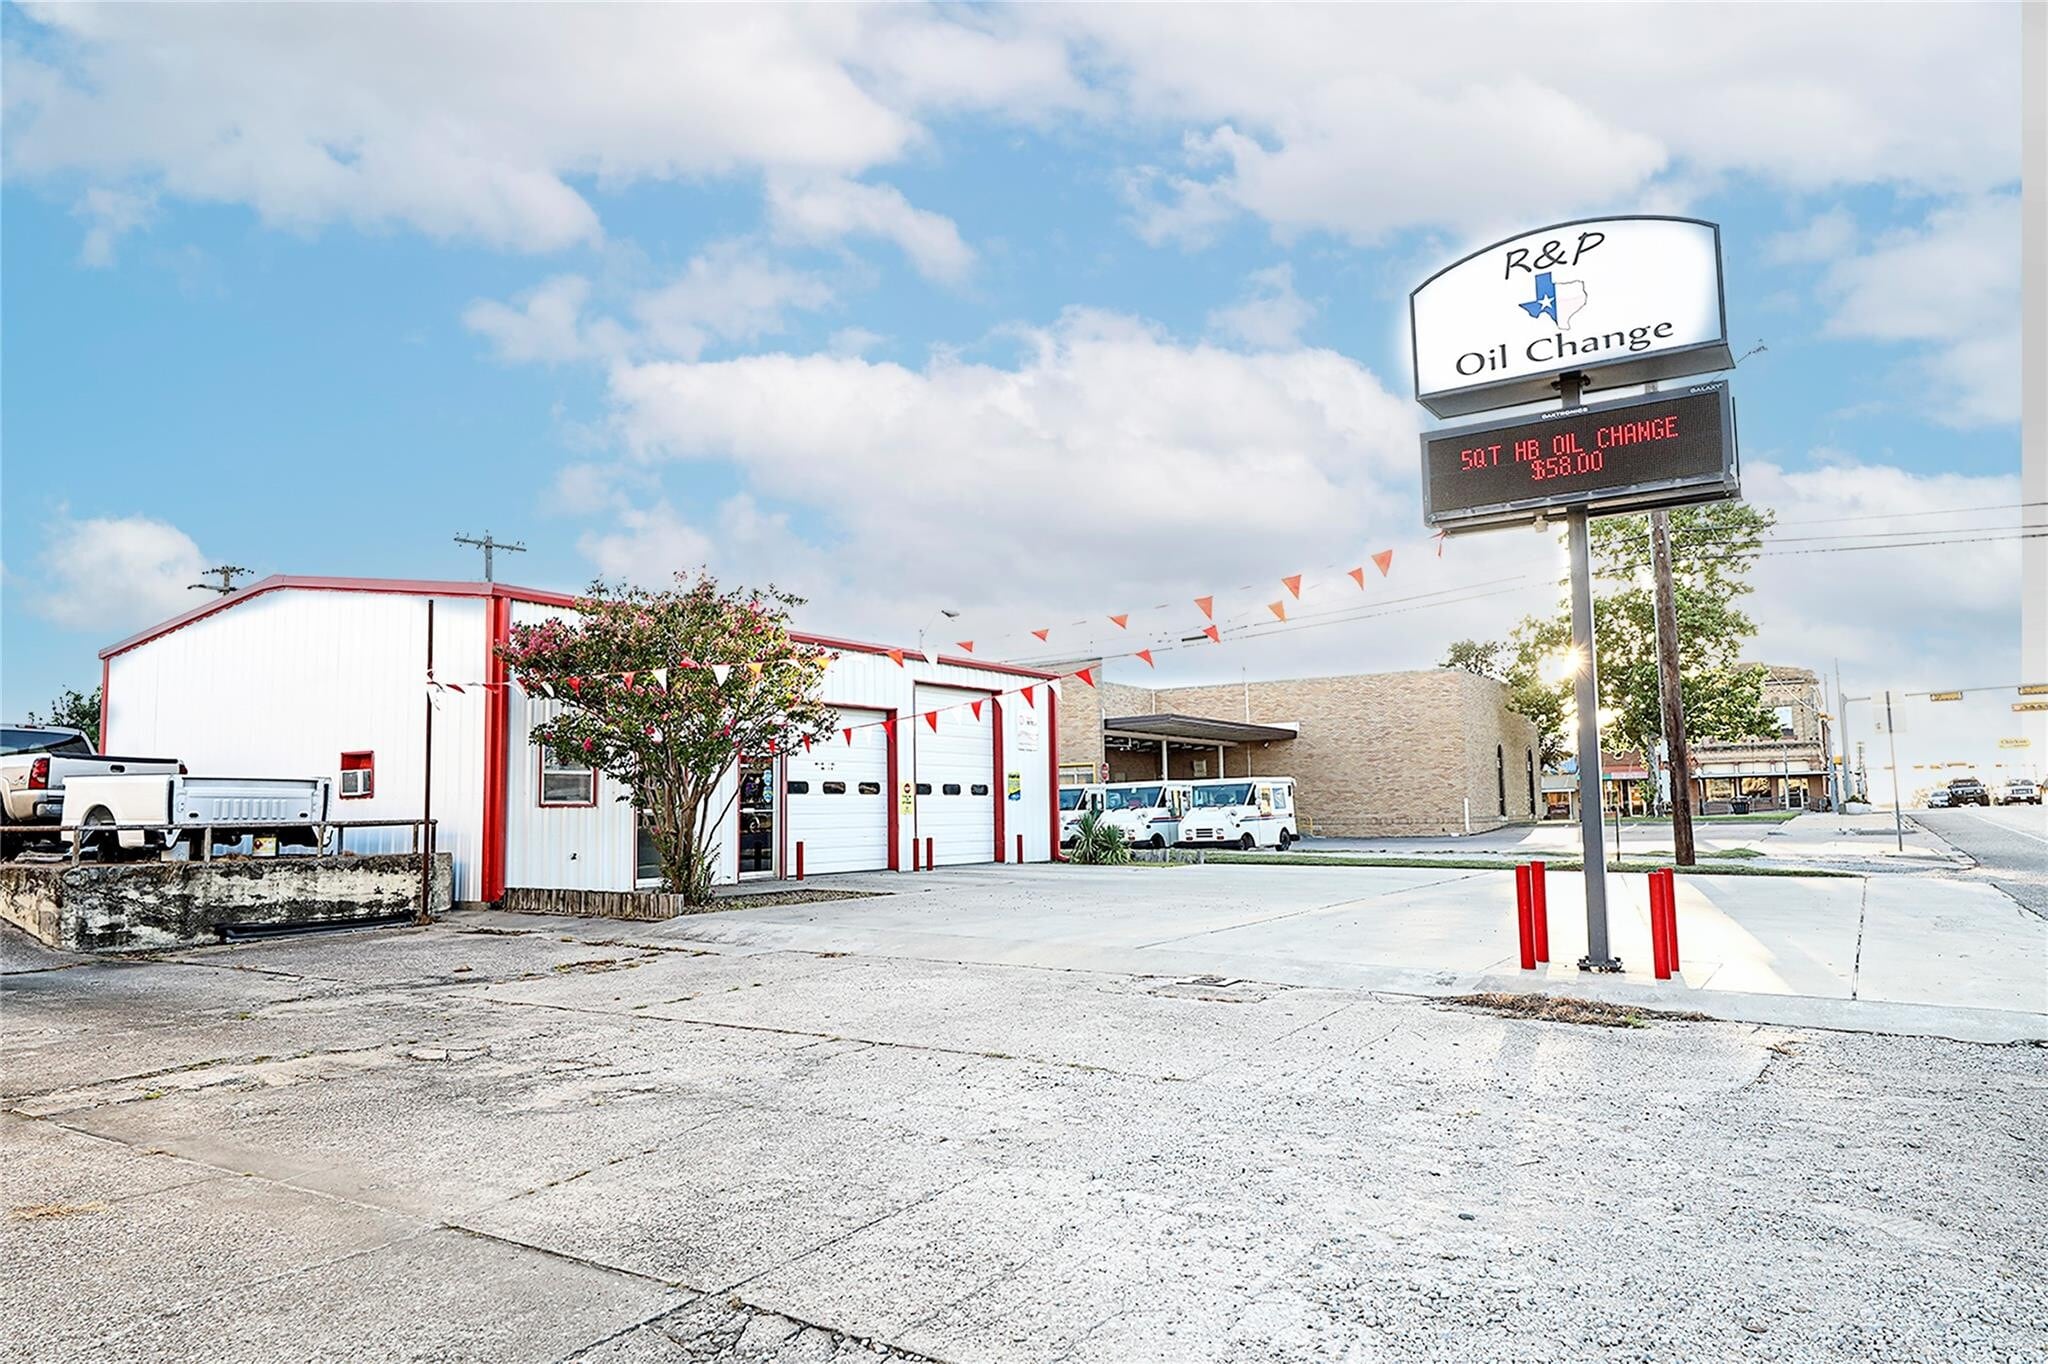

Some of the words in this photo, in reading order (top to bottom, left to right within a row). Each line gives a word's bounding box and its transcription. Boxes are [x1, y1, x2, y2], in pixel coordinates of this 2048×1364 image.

[1505, 232, 1605, 280] R&P
[1455, 343, 1507, 376] Oil
[1526, 321, 1675, 363] Change
[1514, 439, 1540, 462] HB
[1553, 432, 1584, 455] OIL
[1597, 415, 1679, 449] CHANGE
[1531, 450, 1604, 480] $58.00
